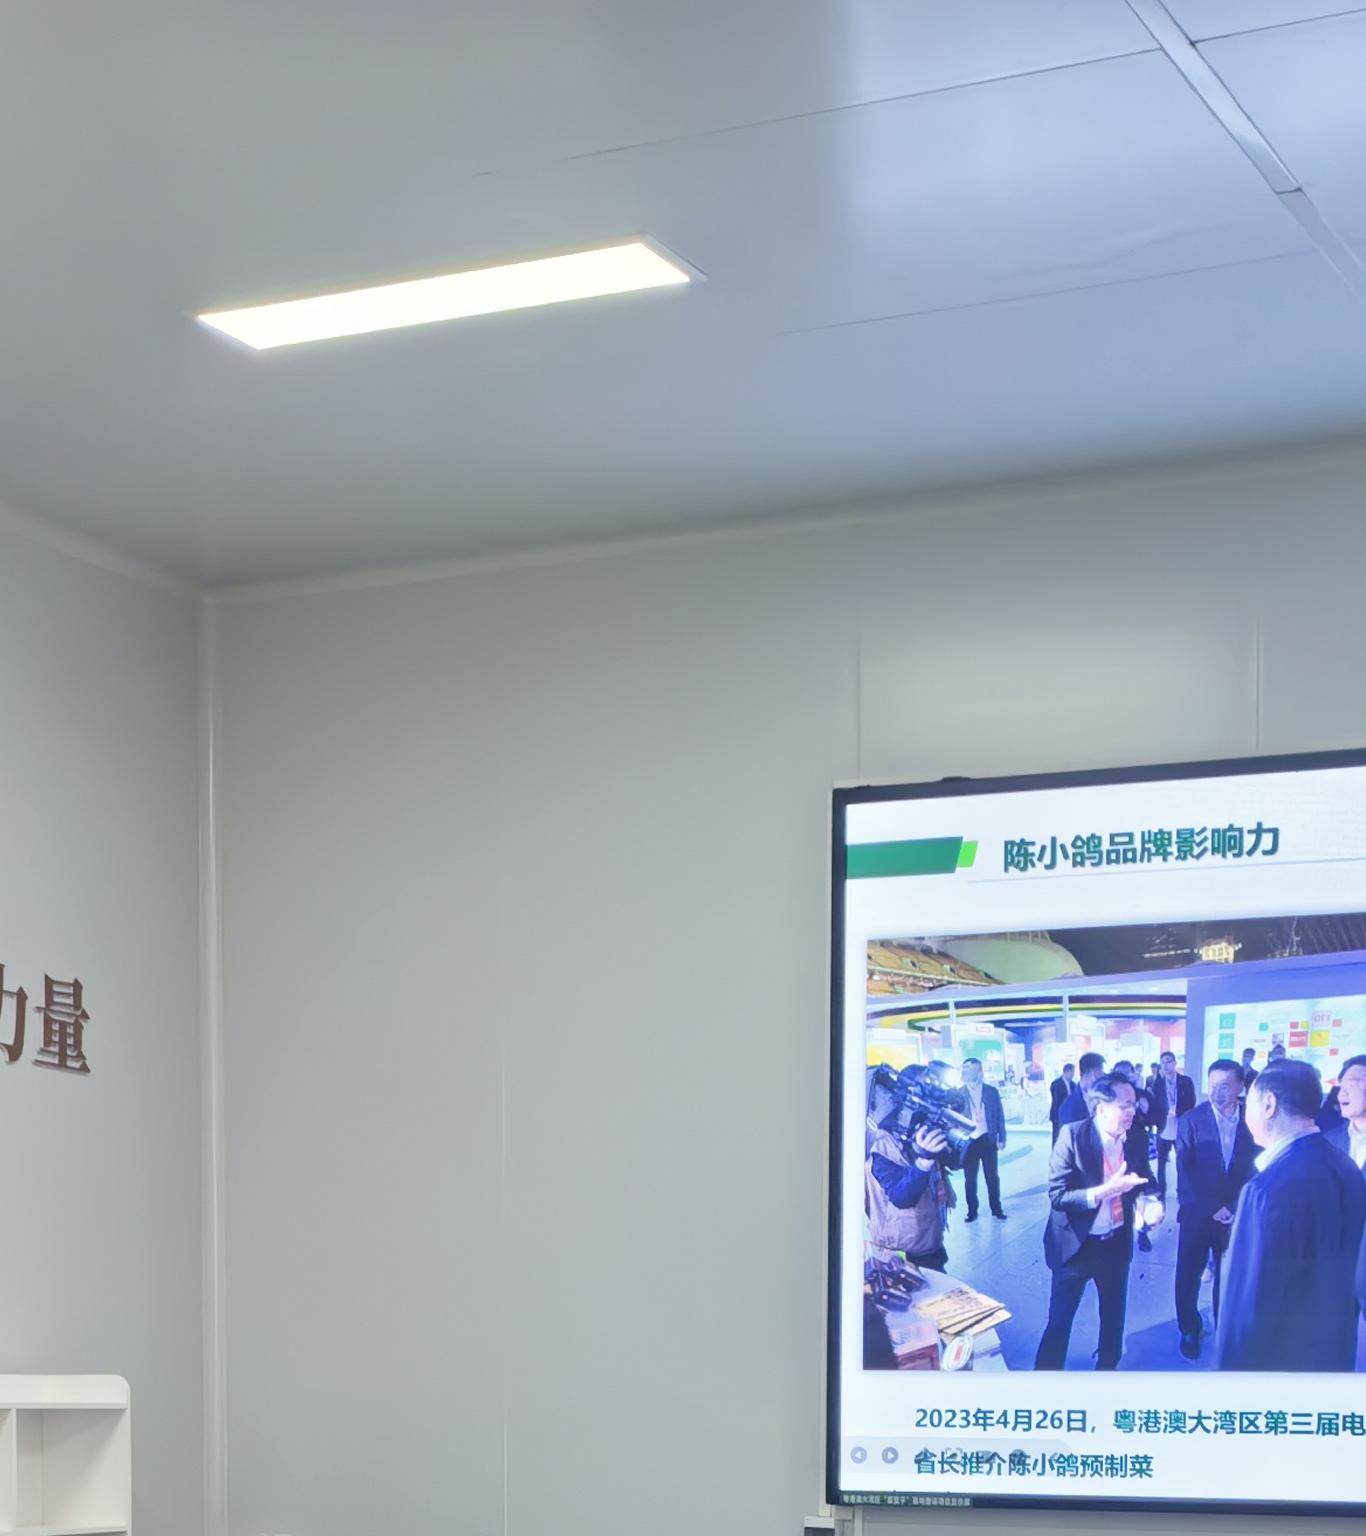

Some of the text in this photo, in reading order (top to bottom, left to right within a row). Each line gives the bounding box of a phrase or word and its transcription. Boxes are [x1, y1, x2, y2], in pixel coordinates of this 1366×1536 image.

[1002, 821, 1281, 873] 陈小鸽品牌影响力
[914, 1450, 1154, 1479] 省长推介陈小鸽预制菜
